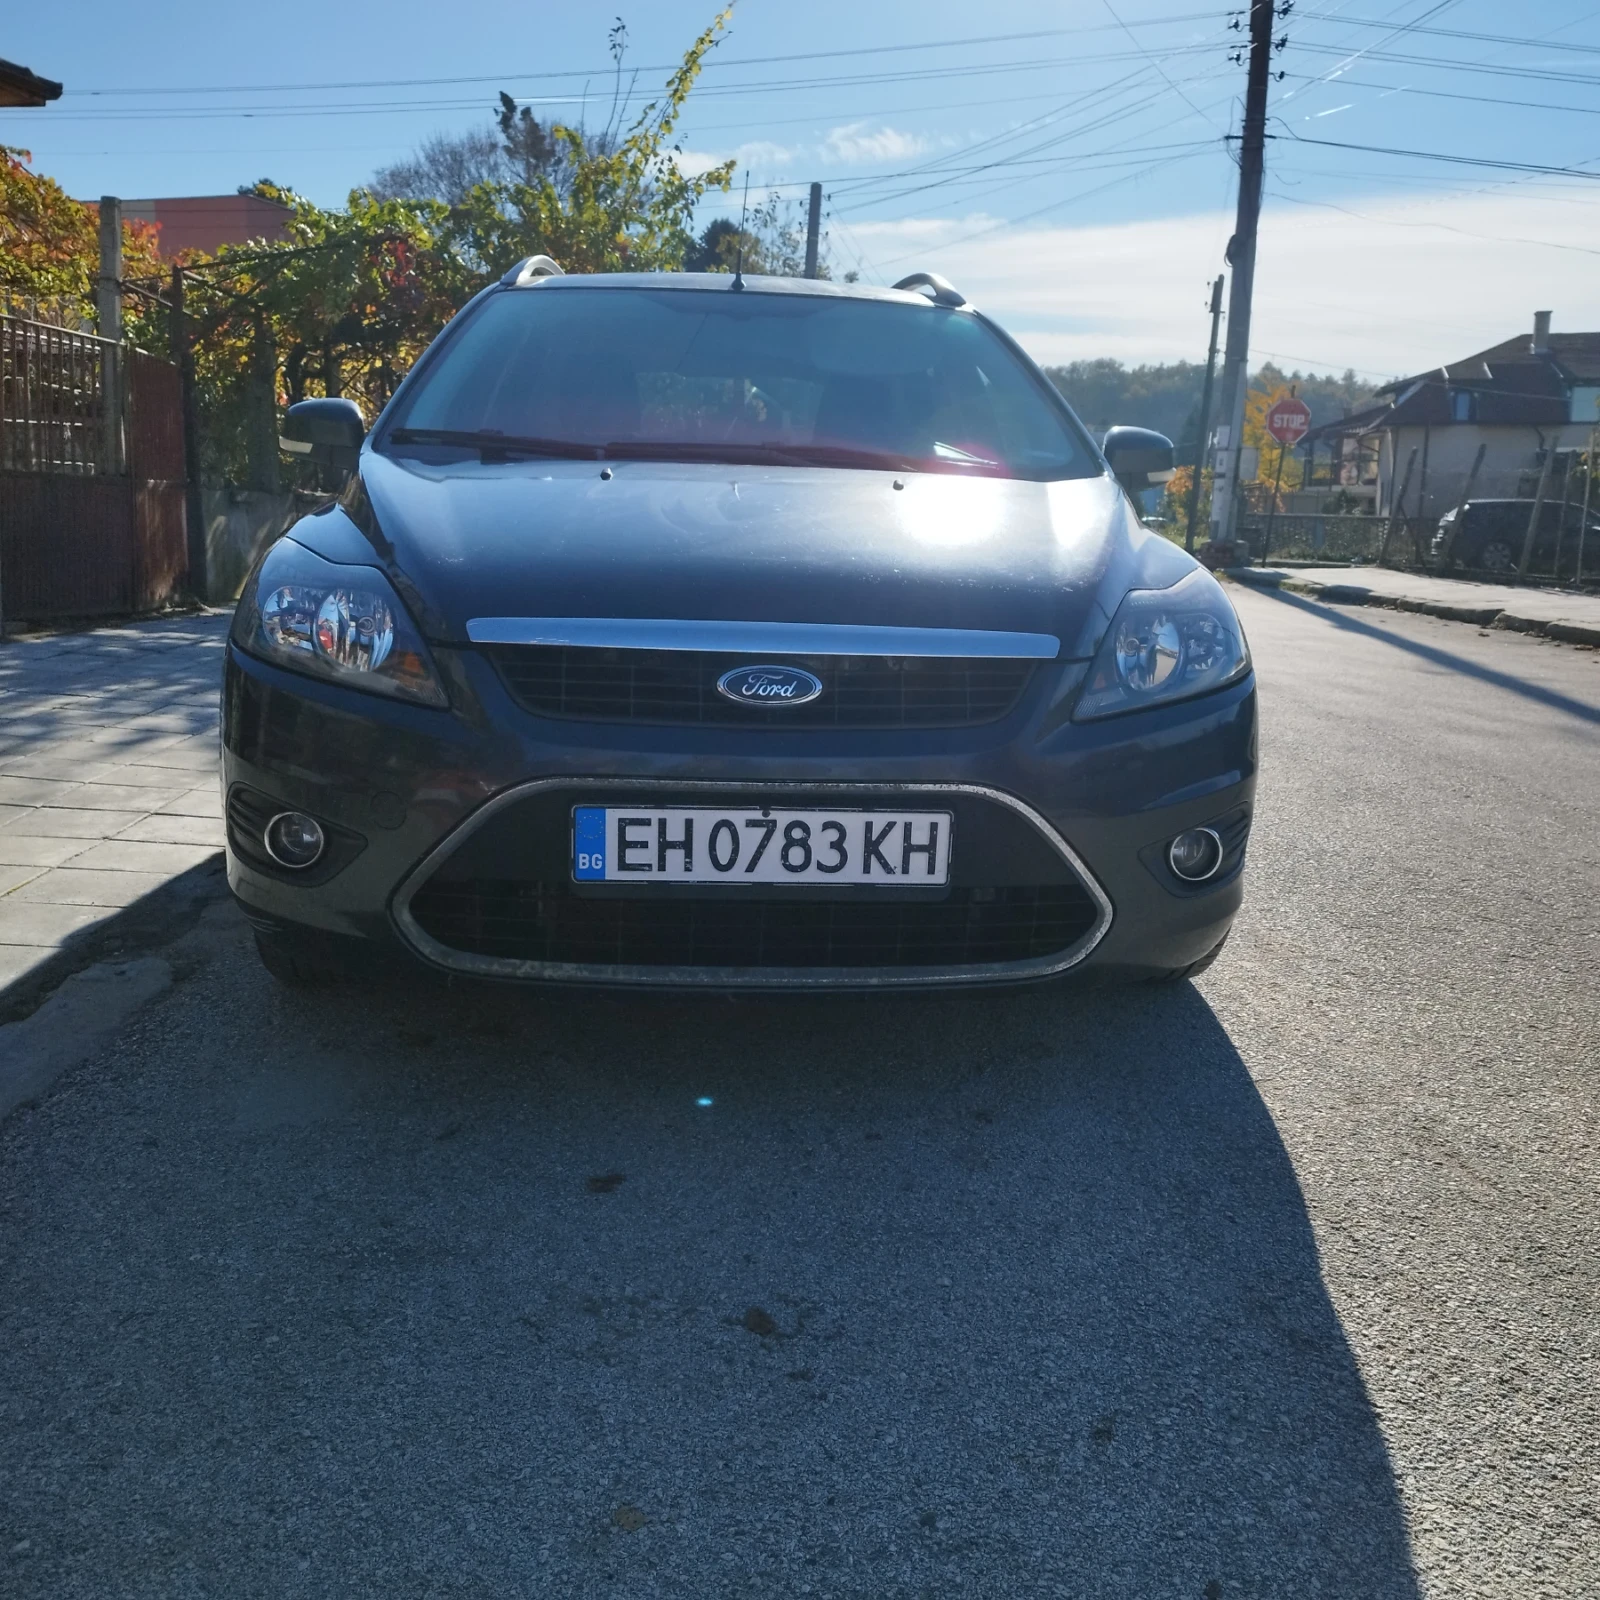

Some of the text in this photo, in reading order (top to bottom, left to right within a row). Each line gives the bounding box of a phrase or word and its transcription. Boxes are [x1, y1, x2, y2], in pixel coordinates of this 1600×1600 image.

[1273, 413, 1305, 428] STOP
[741, 673, 797, 697] Ford
[617, 817, 939, 875] EH 0783 KH
[578, 853, 603, 869] BG
